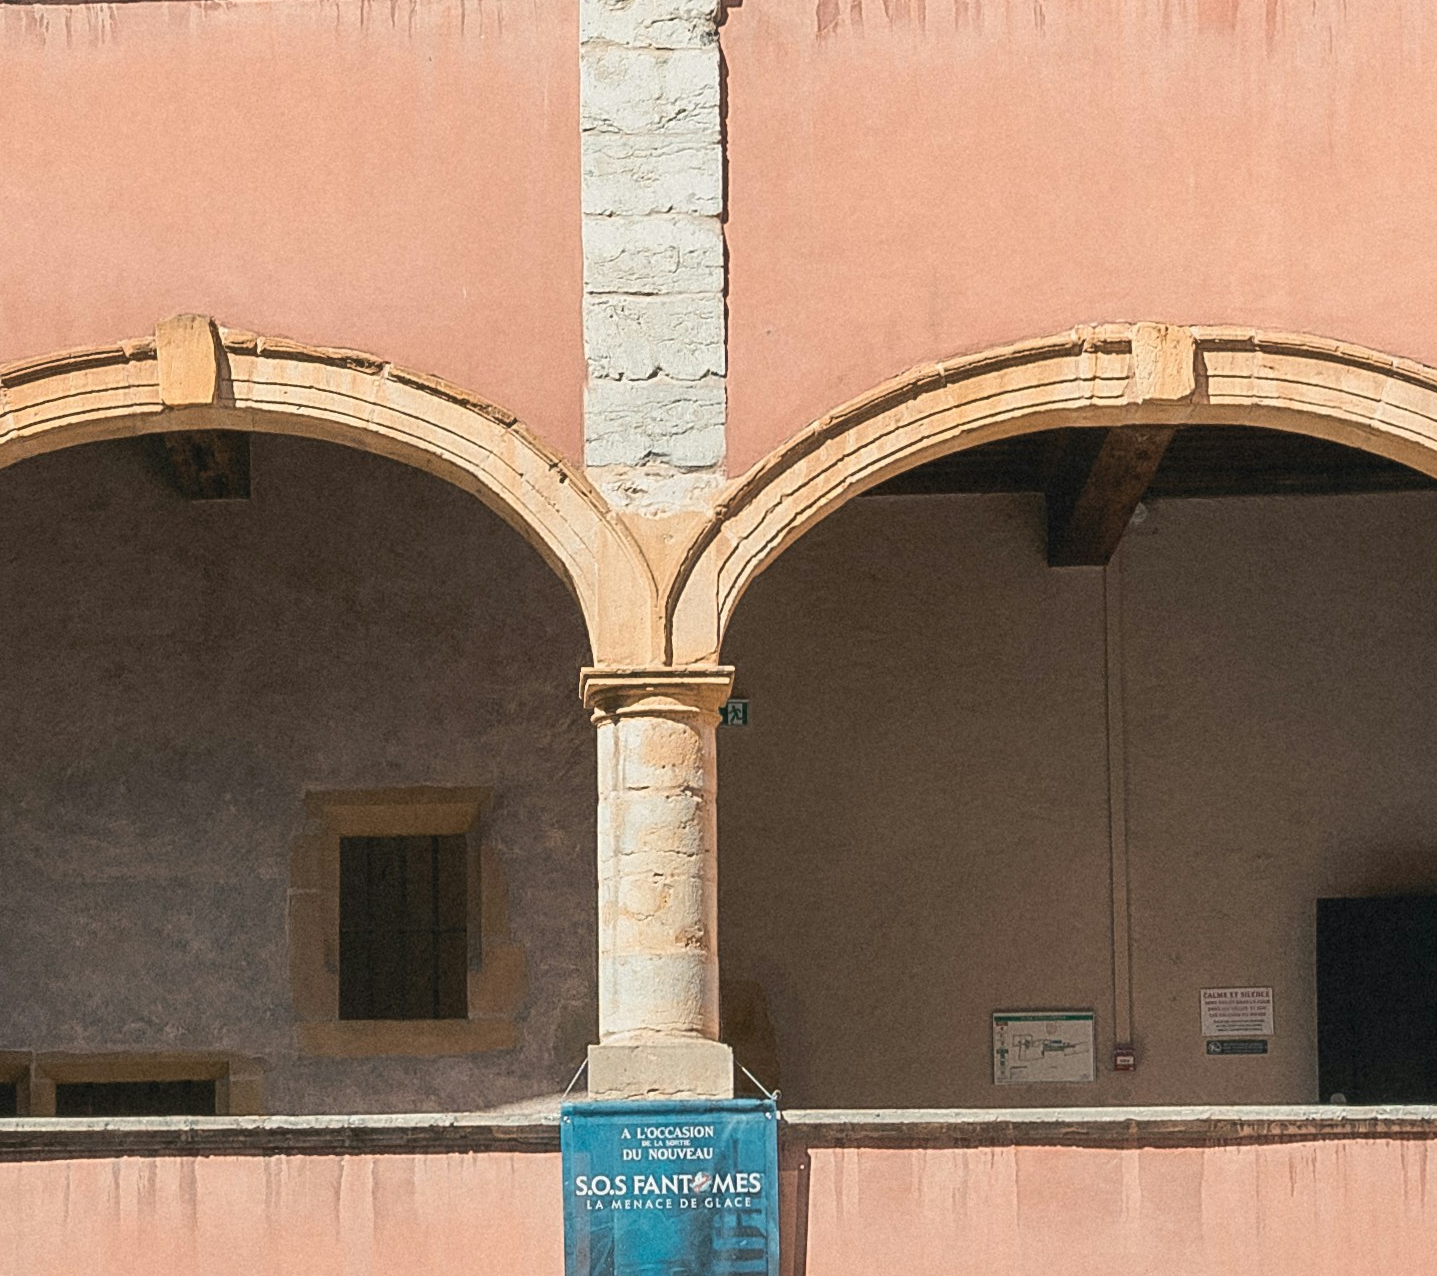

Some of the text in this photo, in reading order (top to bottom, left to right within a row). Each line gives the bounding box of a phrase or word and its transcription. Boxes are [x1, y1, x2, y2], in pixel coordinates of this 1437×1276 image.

[621, 1126, 714, 1139] A L'OCCASION
[623, 1148, 713, 1160] DU NOUVEAU
[575, 1172, 761, 1196] S.O.S FANTMES
[586, 1197, 751, 1210] LA MENACE DE GLACE
